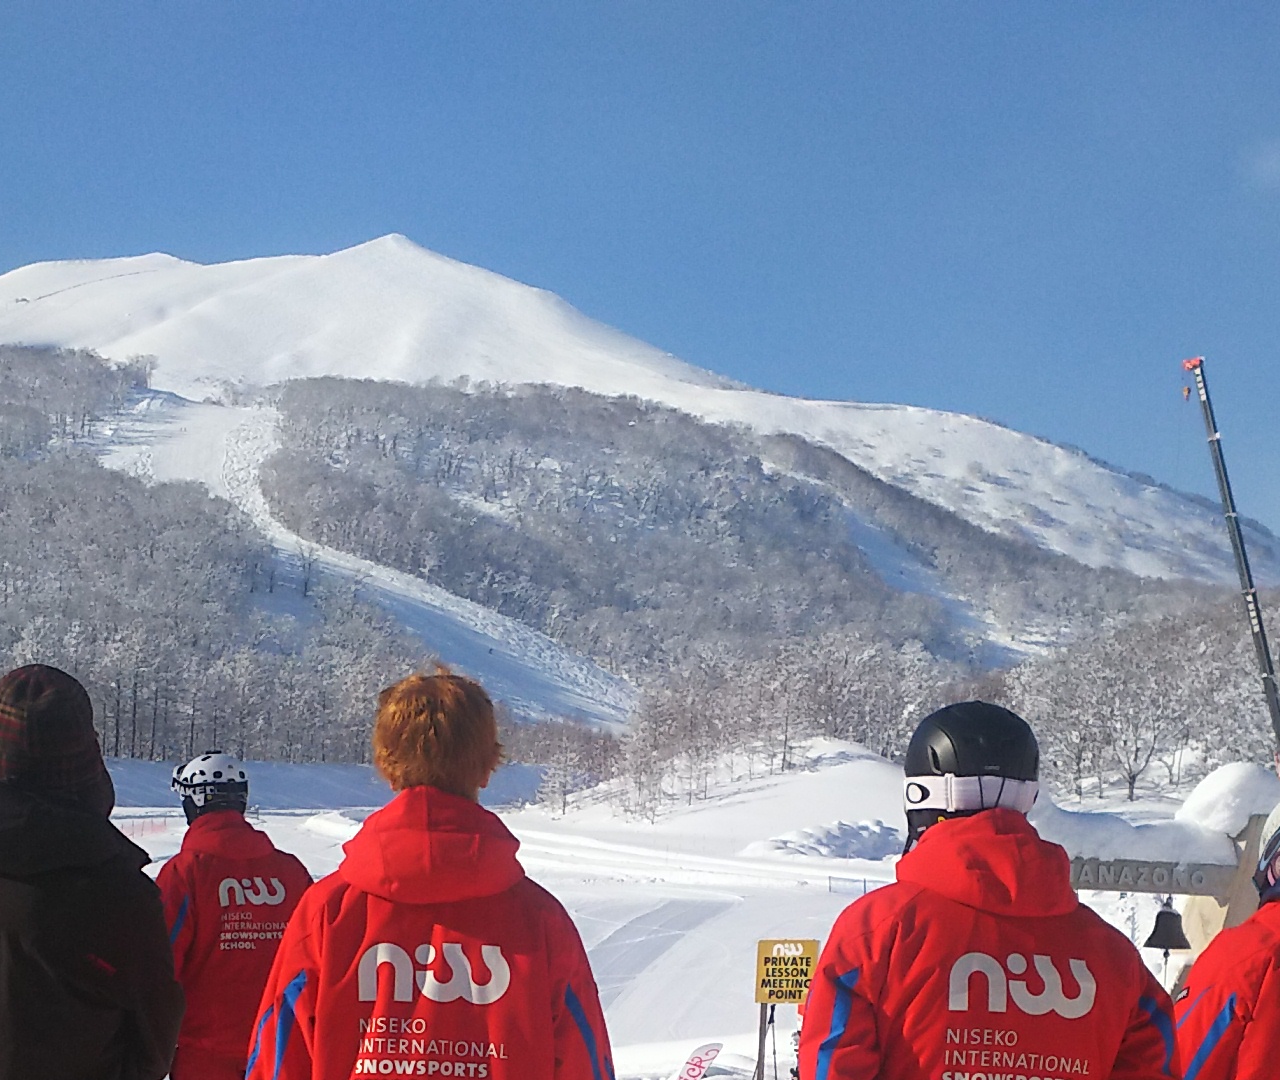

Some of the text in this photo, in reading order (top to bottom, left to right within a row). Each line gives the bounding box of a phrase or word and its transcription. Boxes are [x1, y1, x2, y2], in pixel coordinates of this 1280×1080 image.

[222, 921, 289, 932] INTERNATIONA
[220, 931, 283, 941] SNOWSPORTS
[220, 941, 256, 951] SCHOOL
[763, 956, 812, 967] PRIVATE
[765, 967, 808, 978] LESSON
[768, 989, 804, 1000] POINT
[359, 1017, 427, 1035] NISEKO
[946, 1028, 1018, 1047] NISEKO
[358, 1037, 509, 1060] INTERNATIONAL
[944, 1049, 1090, 1075] INTERNATIONAL
[355, 1058, 488, 1079] SNOWSPORTS
